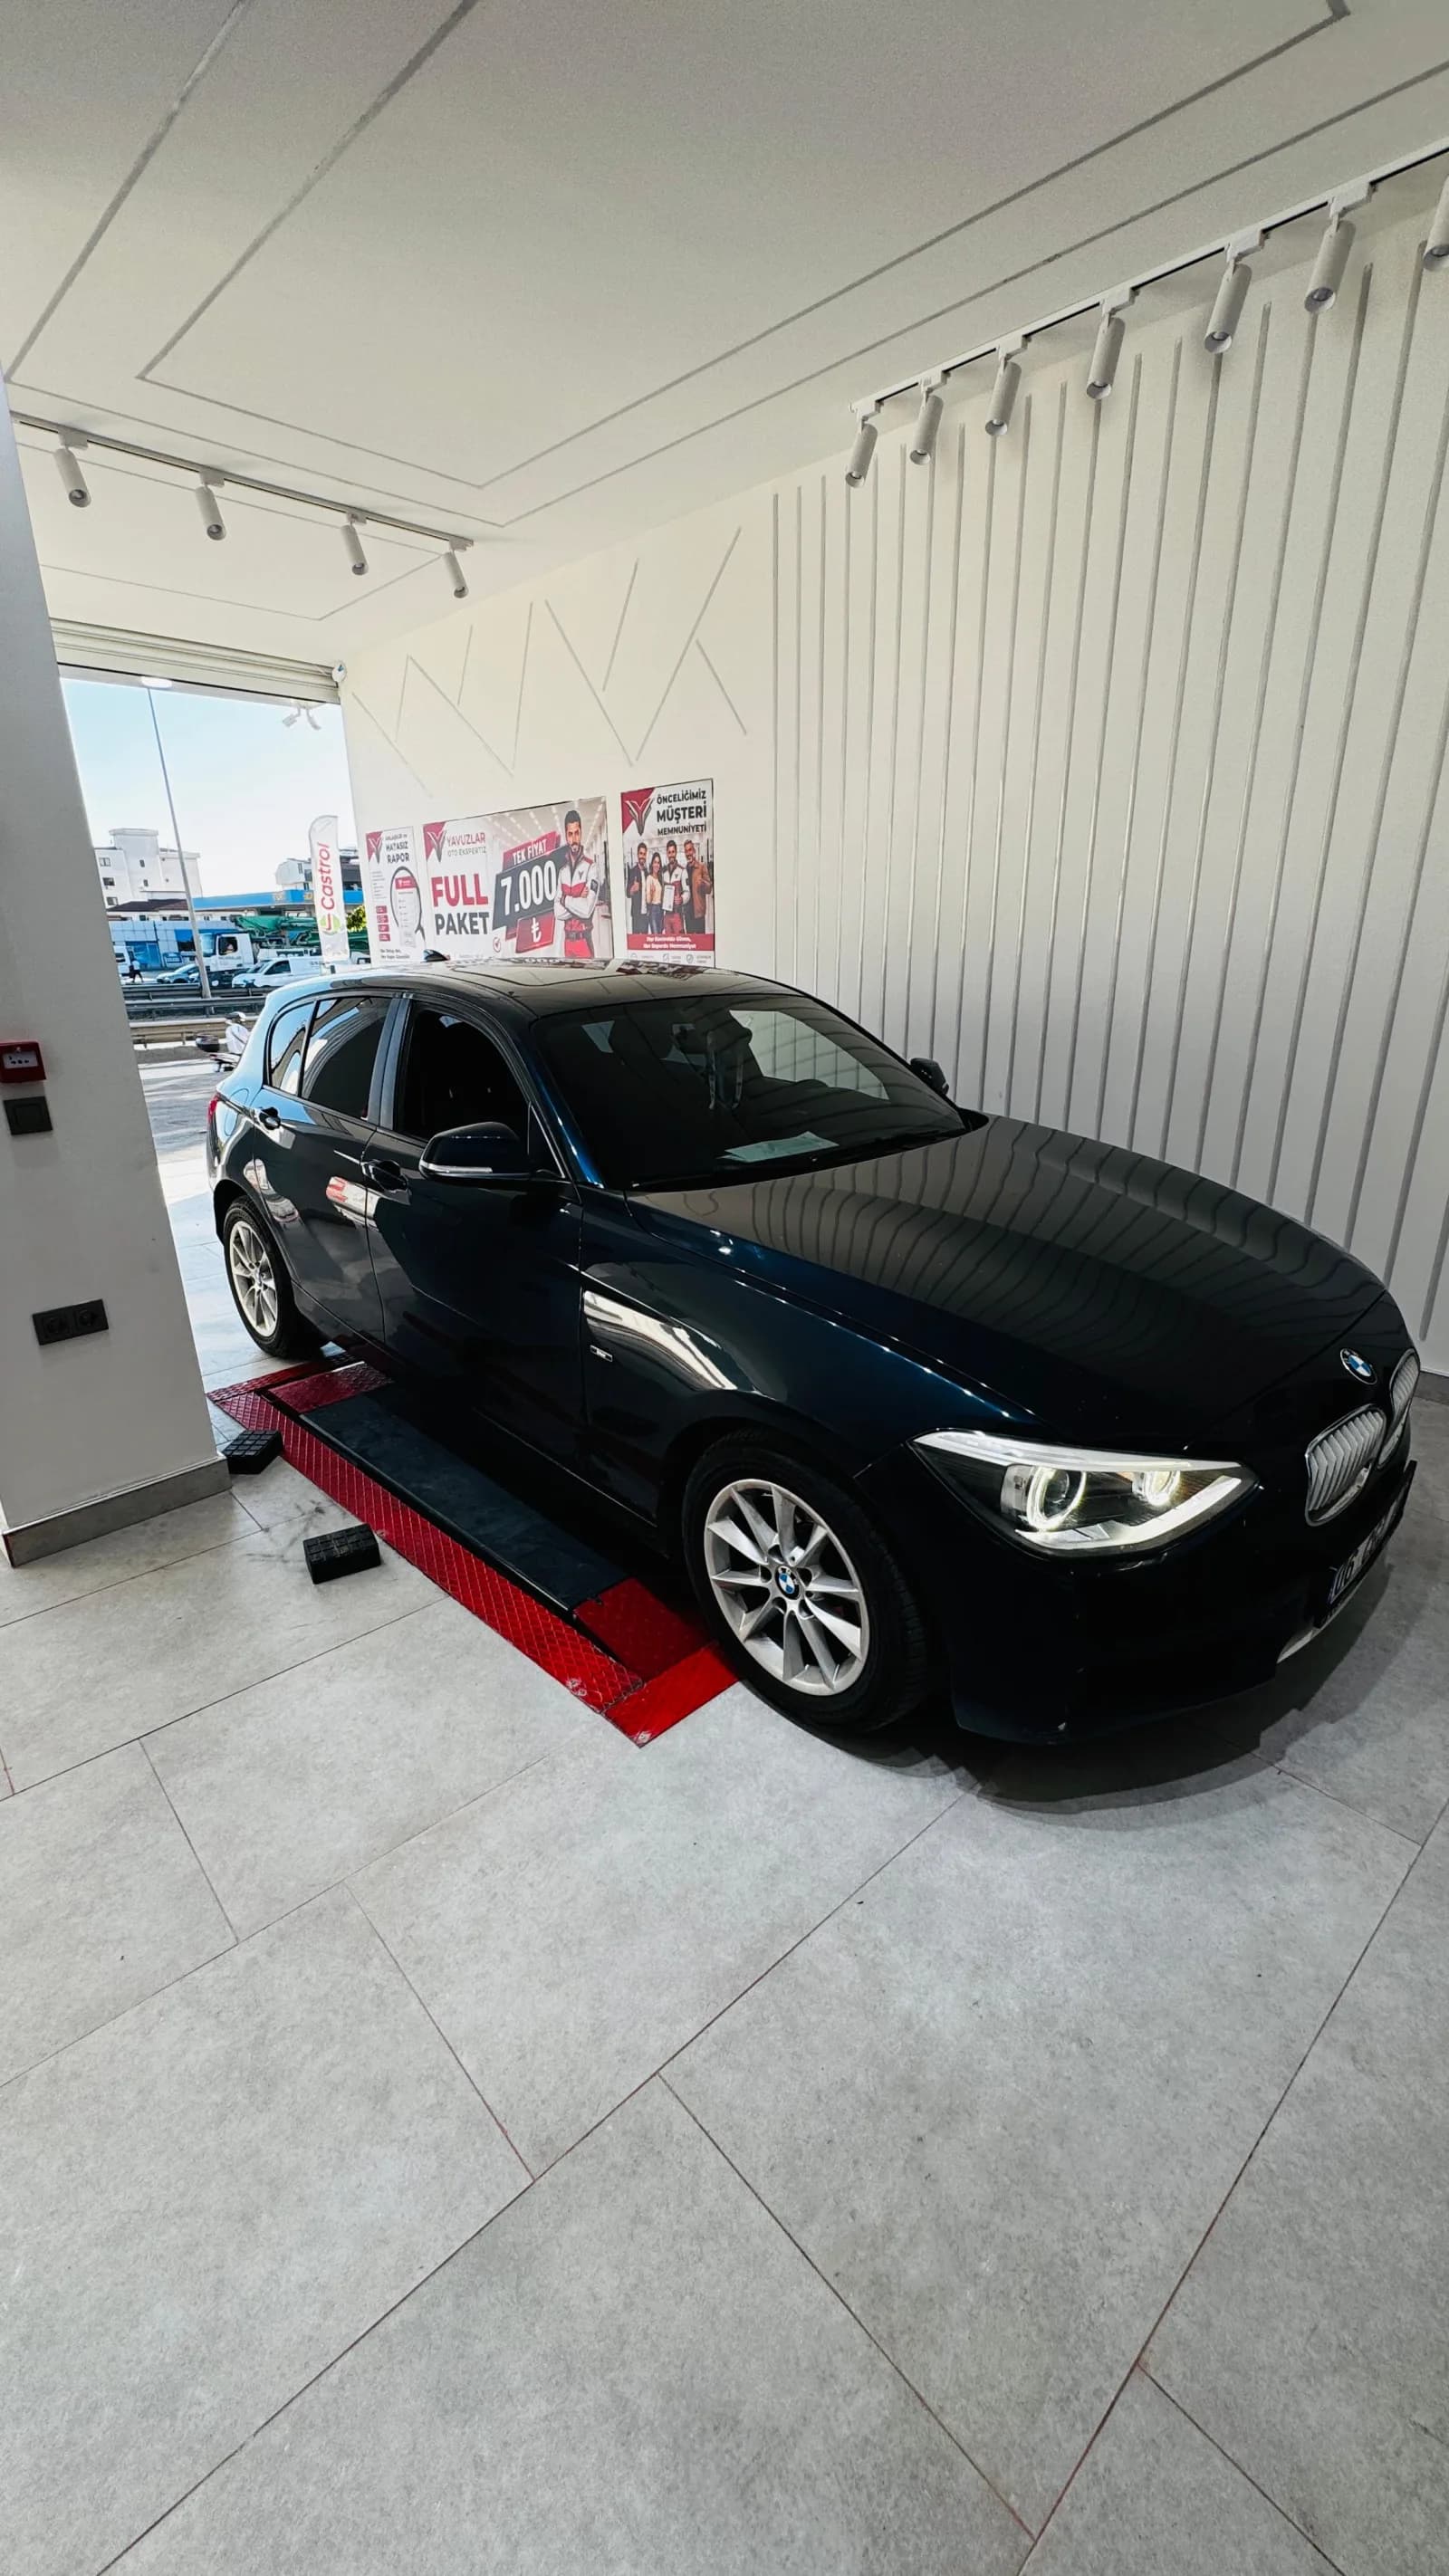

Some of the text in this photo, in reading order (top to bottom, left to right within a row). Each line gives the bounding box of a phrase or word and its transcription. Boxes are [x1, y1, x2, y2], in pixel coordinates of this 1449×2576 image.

[657, 788, 706, 805] ÖNCELİĞİMİZ
[657, 801, 706, 824] MÜŞTERİ
[446, 832, 485, 847] YAVUZLAR
[657, 822, 706, 837] MEMNUNİYETİ
[387, 852, 409, 864] RAPOR
[513, 839, 547, 866] TEK FİYAT
[318, 842, 335, 910] Castrol
[431, 873, 489, 907] FULL
[500, 860, 558, 916] 7.000
[435, 911, 490, 935] PAKET
